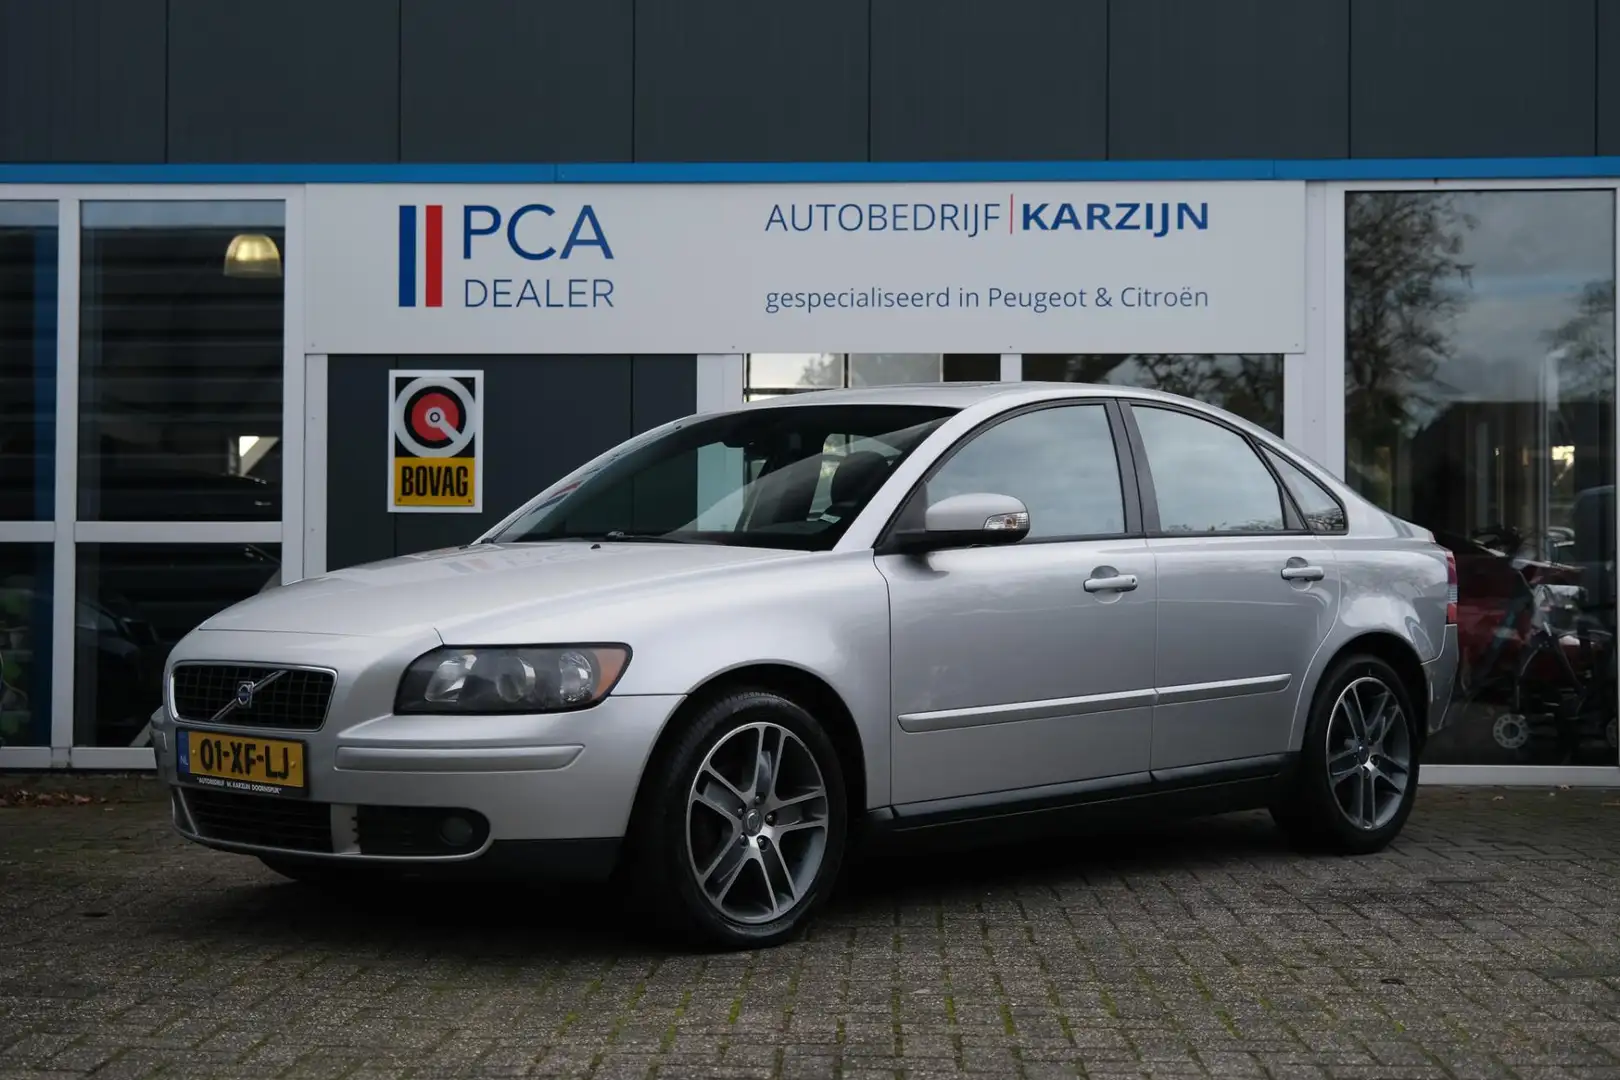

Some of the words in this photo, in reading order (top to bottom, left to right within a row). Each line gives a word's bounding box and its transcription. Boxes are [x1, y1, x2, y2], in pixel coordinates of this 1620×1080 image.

[462, 203, 615, 261] PCA
[764, 203, 1001, 239] AUTOBEDRIJF
[1022, 202, 1209, 238] KARZIJN
[464, 278, 614, 308] DEALER
[765, 286, 950, 314] gespecialiseerd
[959, 287, 979, 308] in
[988, 287, 1087, 314] Peugeot
[1095, 287, 1114, 308] &
[1120, 286, 1209, 308] Citroën
[401, 465, 469, 497] BOVAG
[180, 755, 189, 766] NL
[200, 738, 290, 779] 01-XF-LJ
